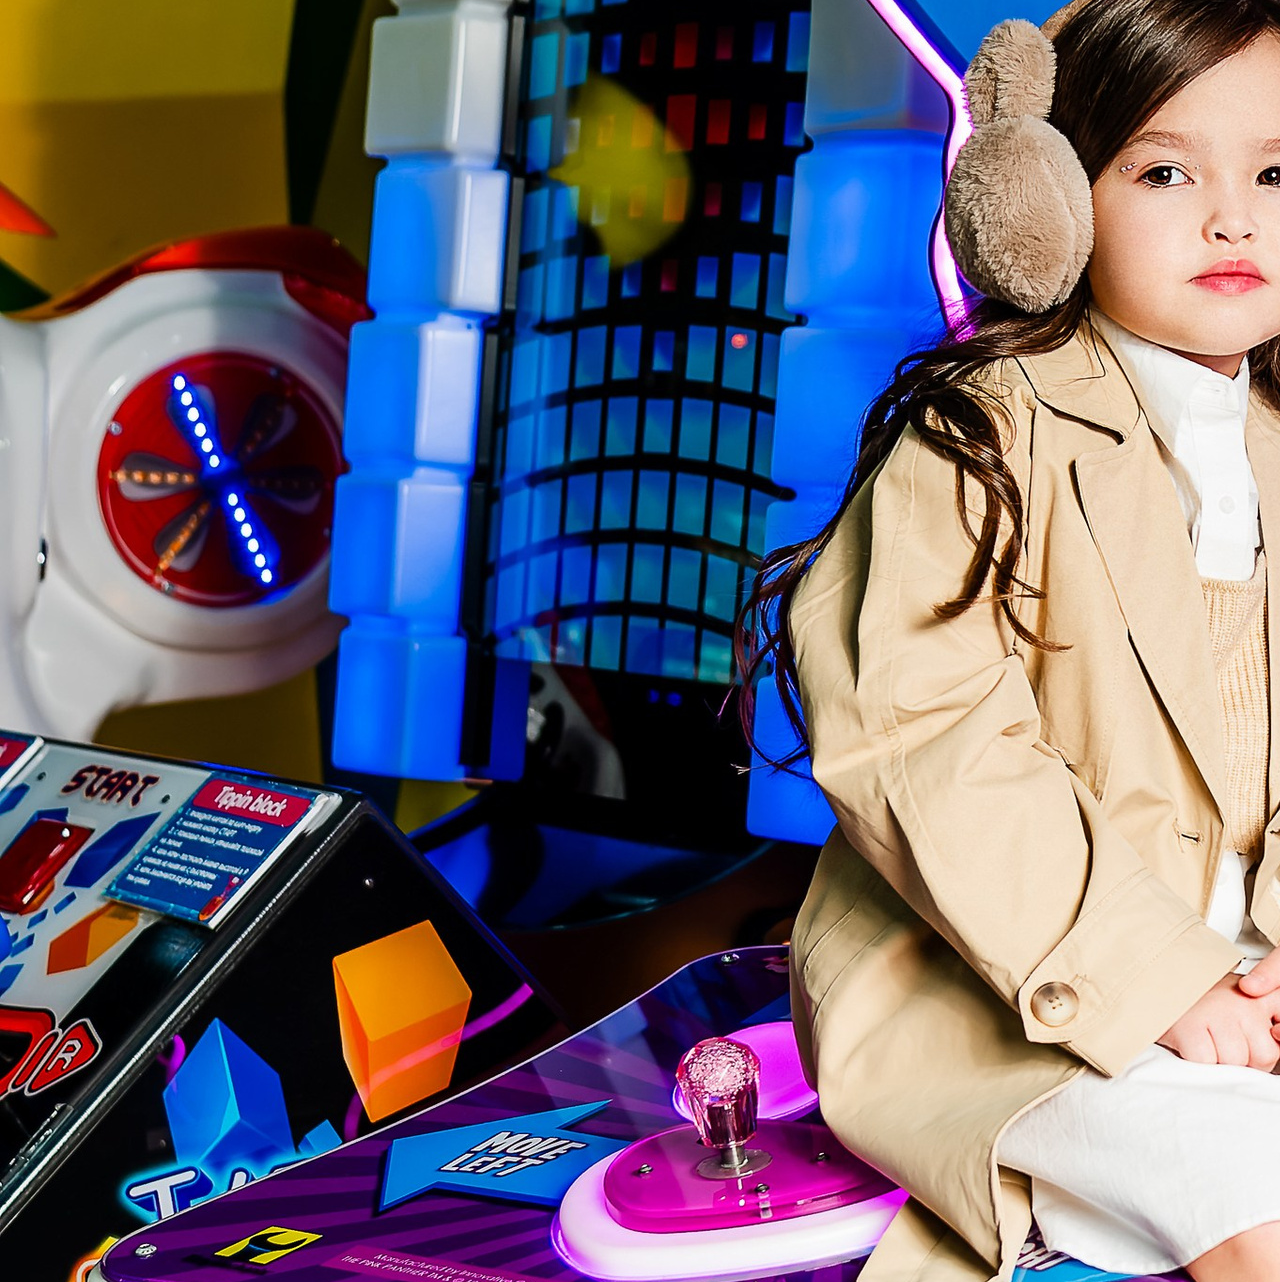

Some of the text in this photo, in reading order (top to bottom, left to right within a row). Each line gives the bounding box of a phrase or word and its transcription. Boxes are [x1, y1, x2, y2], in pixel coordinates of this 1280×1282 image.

[60, 764, 161, 807] START
[470, 1130, 589, 1160] MOVE
[439, 1152, 545, 1178] LEFT
